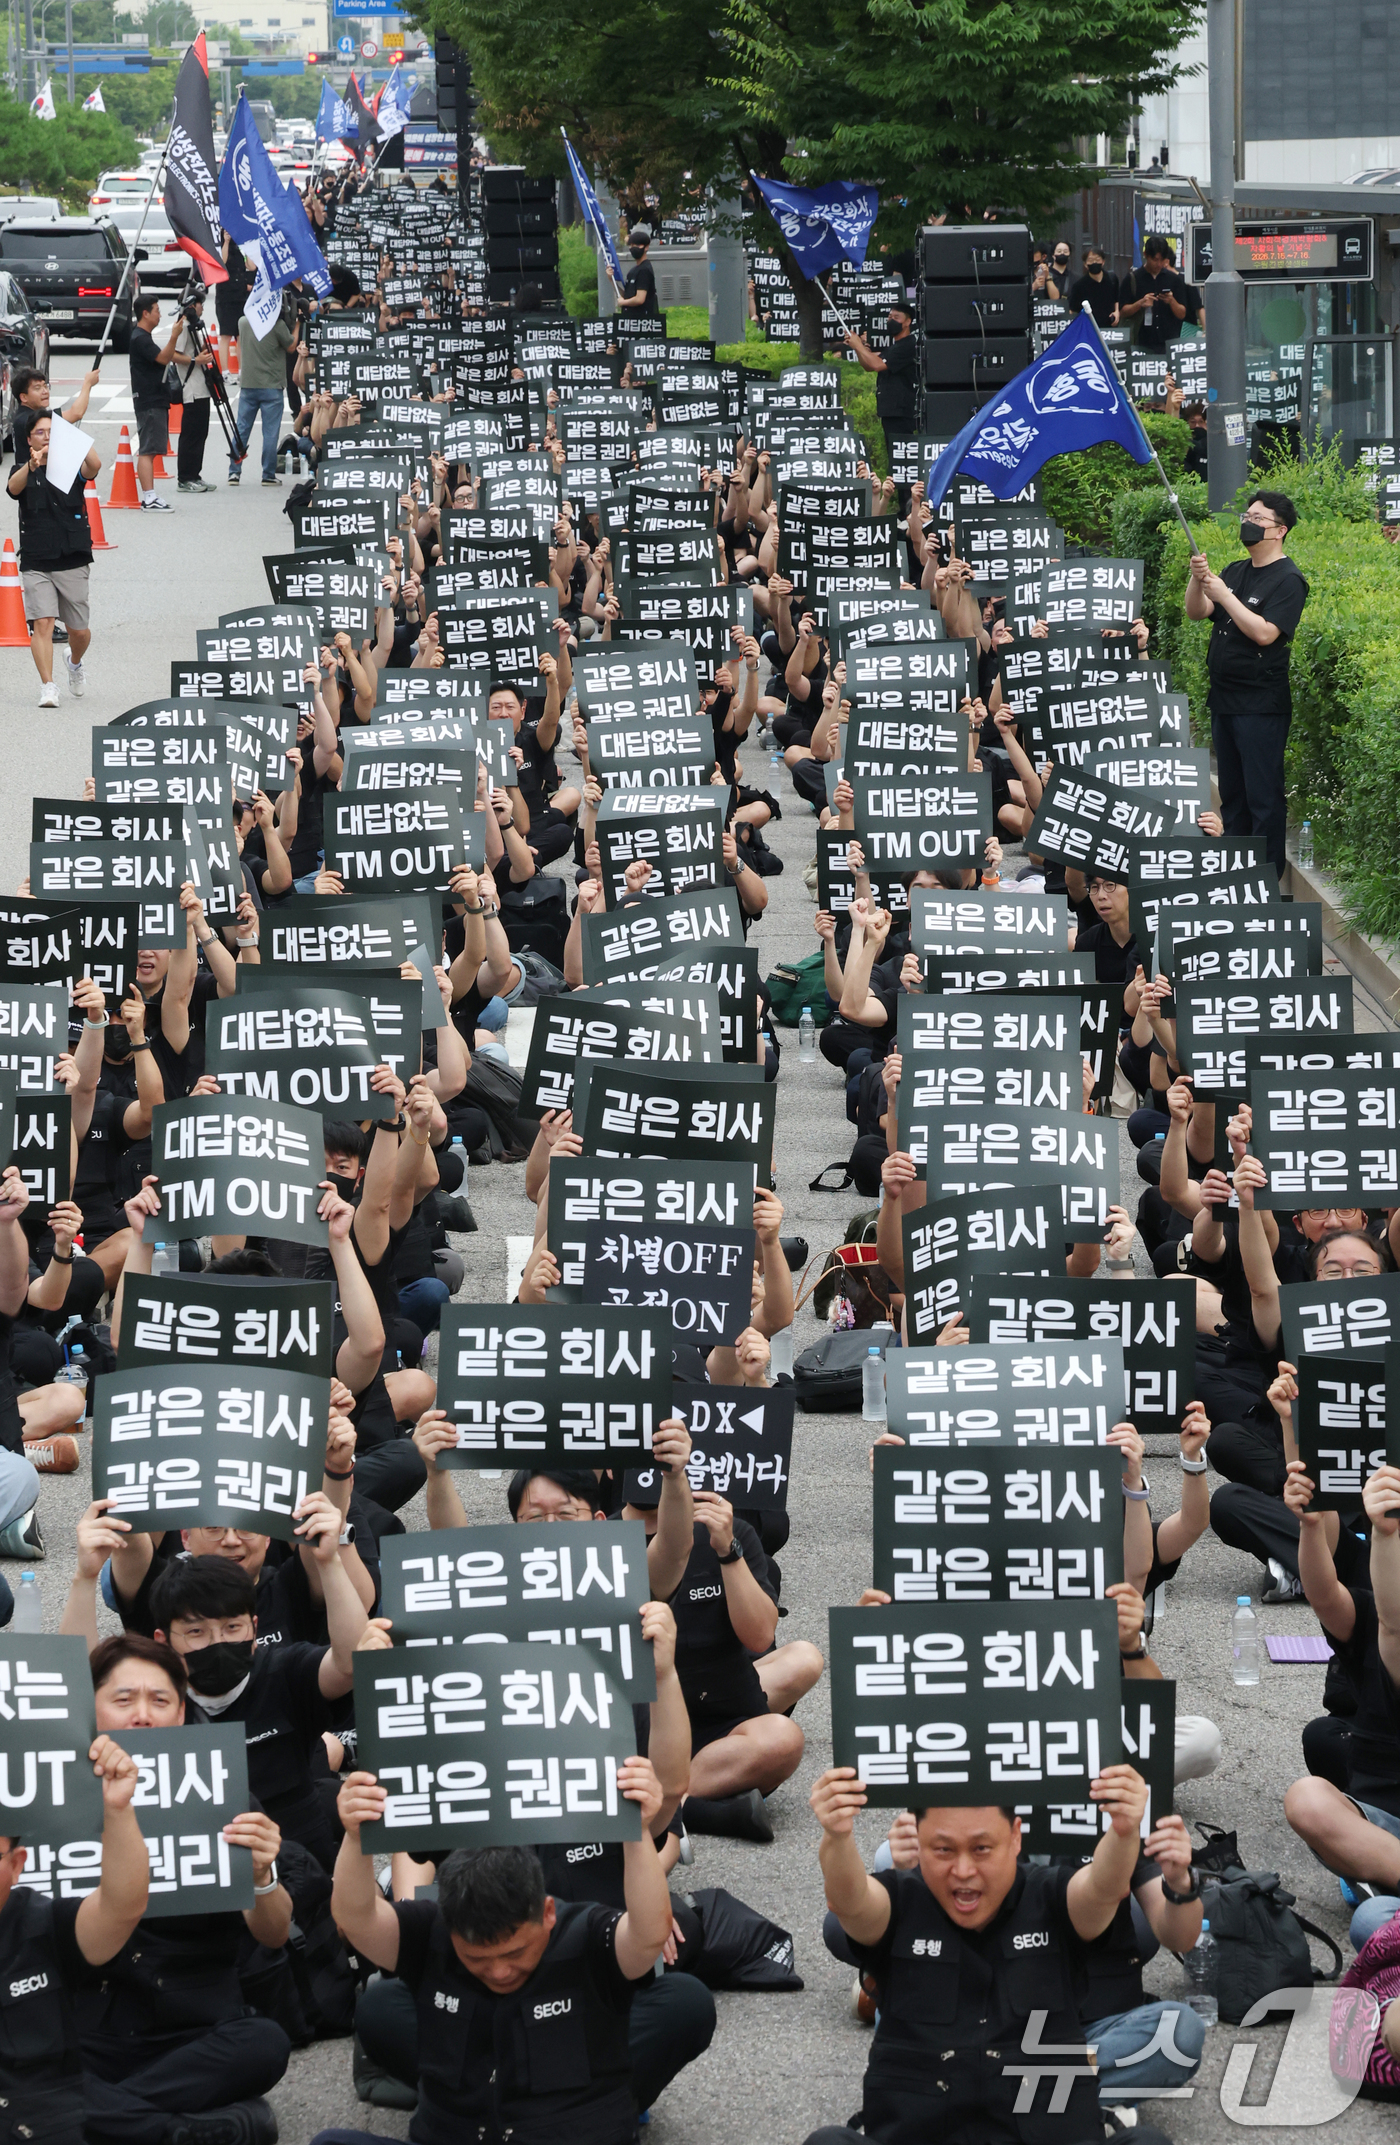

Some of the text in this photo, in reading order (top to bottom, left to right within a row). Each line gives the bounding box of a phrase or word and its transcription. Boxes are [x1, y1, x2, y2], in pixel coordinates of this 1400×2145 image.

[327, 327, 371, 339] 대답없는
[669, 347, 711, 360] 대답없는
[468, 387, 524, 405] 같은 회사
[444, 442, 472, 460] 같은
[777, 460, 841, 481] 같은 회사
[302, 513, 375, 536] 대답없는
[972, 559, 1009, 580] 같은
[1048, 568, 1136, 592] 같은 회사
[206, 636, 303, 661] 같은 회사
[848, 624, 888, 649] 같은
[496, 646, 539, 671] 권리
[583, 659, 687, 692] 같은 회사
[1005, 651, 1042, 679] 같은
[180, 671, 274, 697] 같은 회사
[1049, 695, 1148, 728] 대답없는
[352, 724, 462, 746] 같은 회사
[600, 729, 701, 757] 대답없는
[858, 722, 958, 752] 대답없는
[167, 777, 222, 805] 회사
[1096, 760, 1198, 786] 대답없는
[612, 795, 715, 813] 대답없는
[868, 787, 978, 817] 대답없는
[1053, 778, 1163, 837] 같은 회사
[608, 822, 714, 860] 같은 회사
[867, 830, 980, 858] TM OUT
[1038, 817, 1092, 860] 같은
[42, 856, 175, 889] 같은 회사
[336, 845, 454, 879] TM OUT
[924, 902, 1056, 936] 같은 회사
[7, 929, 71, 967] 회사
[273, 924, 392, 961] 대답없는
[1228, 948, 1295, 979] 회사
[221, 1007, 368, 1050] 대답없는
[913, 1013, 1067, 1050] 같은 회사
[1191, 993, 1340, 1034] 같은 회사
[546, 1016, 617, 1058] 같은
[290, 1065, 376, 1104] OUT
[913, 1068, 1070, 1110] 같은 회사
[602, 1089, 762, 1143] 같은 회사
[1268, 1088, 1400, 1131] 같은 회
[165, 1114, 309, 1166] 대답없는
[944, 1124, 1106, 1169] 같은 회사
[1269, 1150, 1348, 1192] 같은
[162, 1178, 313, 1223] TM OUT
[565, 1179, 738, 1225] 같은 회사
[596, 1234, 742, 1276] 차별OFF
[911, 1206, 1048, 1272] 같은 회사
[914, 1279, 959, 1334] 같은
[989, 1298, 1076, 1344] 같은
[135, 1299, 319, 1357] 같은 회사
[1299, 1299, 1391, 1352] 같은
[458, 1328, 655, 1379] 같은 회사
[906, 1354, 1106, 1393] 같은 회사
[111, 1387, 313, 1446] 같은 회사
[453, 1401, 653, 1450] 같은 권리
[690, 1400, 736, 1434] DX
[107, 1458, 308, 1520] 같은 권리
[894, 1470, 1104, 1523] 같은 회사
[402, 1546, 629, 1612] 같은 회사
[689, 1585, 721, 1600] SECU
[893, 1548, 1104, 1600] 같은 권리
[853, 1629, 1099, 1695] 같은 회사
[375, 1670, 612, 1738] 같은 회사
[853, 1719, 1101, 1788] 같은 권리
[378, 1756, 617, 1827] 같은 권리
[566, 1843, 603, 1863] SECU
[912, 1940, 941, 1956] 동행
[1013, 1932, 1048, 1949] SECU
[10, 1973, 48, 1997] SECU
[435, 1992, 459, 2013] 동행
[534, 1999, 571, 2019] SECU
